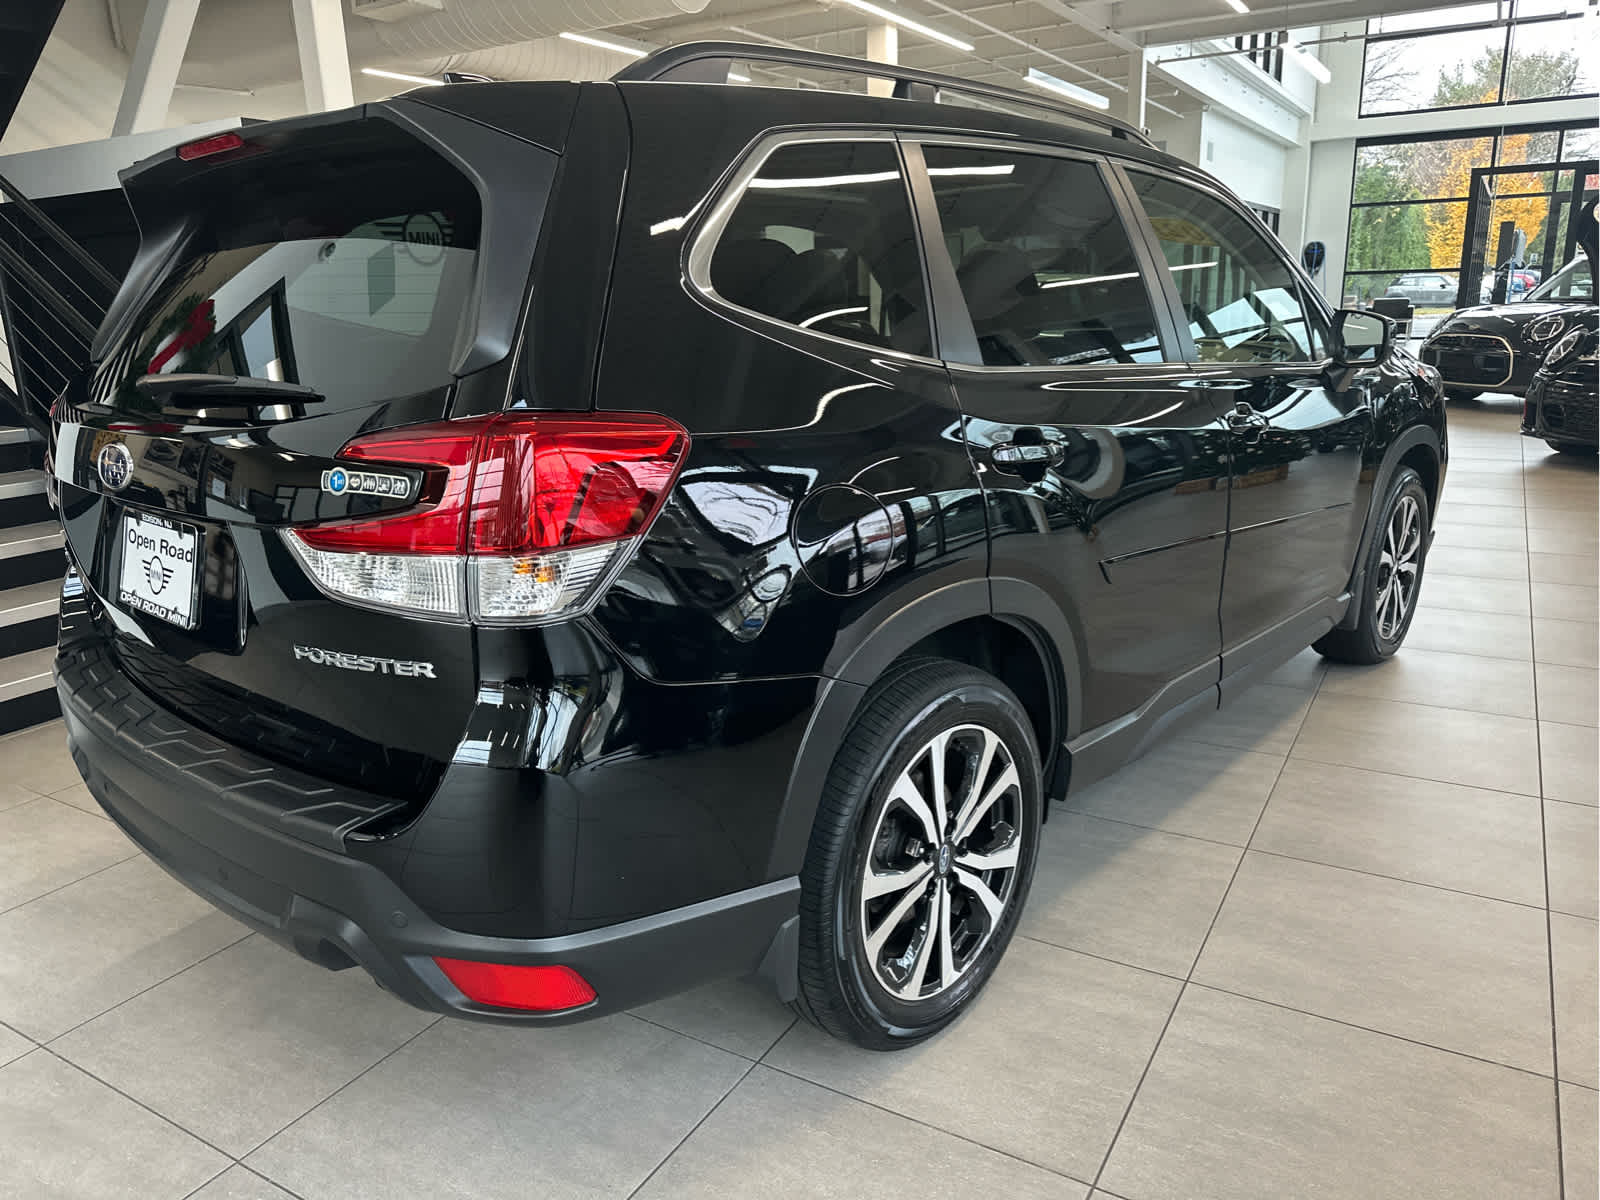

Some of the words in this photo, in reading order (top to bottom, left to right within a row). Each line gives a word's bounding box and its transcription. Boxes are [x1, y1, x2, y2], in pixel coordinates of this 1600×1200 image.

[407, 231, 441, 247] MINI
[128, 528, 156, 551] Open
[160, 539, 194, 563] Road
[120, 591, 141, 608] OPEN
[142, 600, 167, 617] ROAD
[167, 610, 188, 629] MINI
[293, 644, 438, 679] FORESTER
